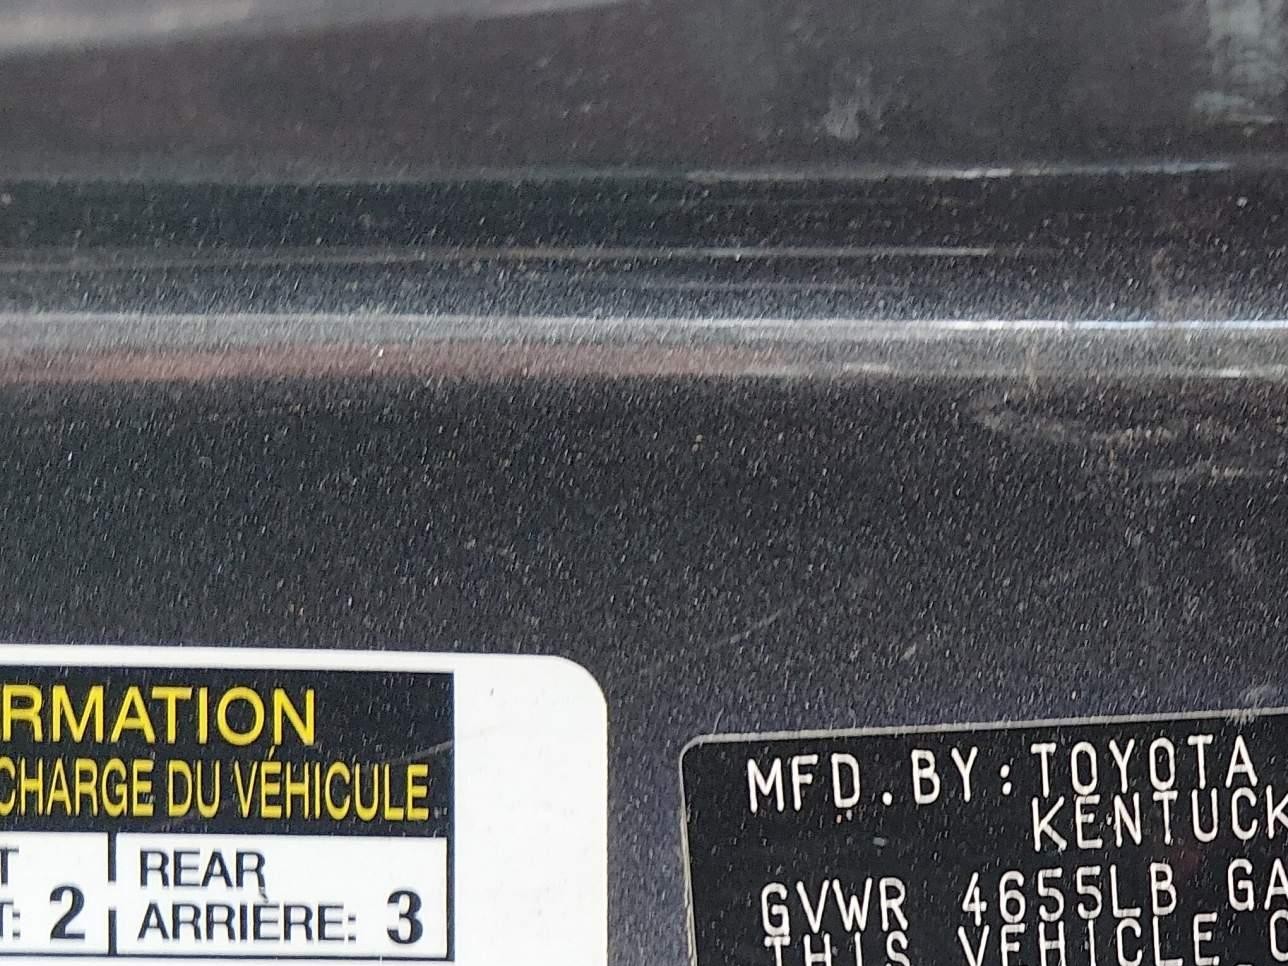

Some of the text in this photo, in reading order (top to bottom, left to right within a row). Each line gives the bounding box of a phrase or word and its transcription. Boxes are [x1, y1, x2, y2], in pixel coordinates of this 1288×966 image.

[167, 758, 221, 818] DU
[233, 745, 430, 821] VÉHICULE
[139, 848, 267, 888] REAR
[49, 885, 87, 941] 2
[137, 886, 425, 946] ARRIÈRE: 3
[760, 876, 909, 937] GVWR
[962, 862, 1177, 927] 4655LB
